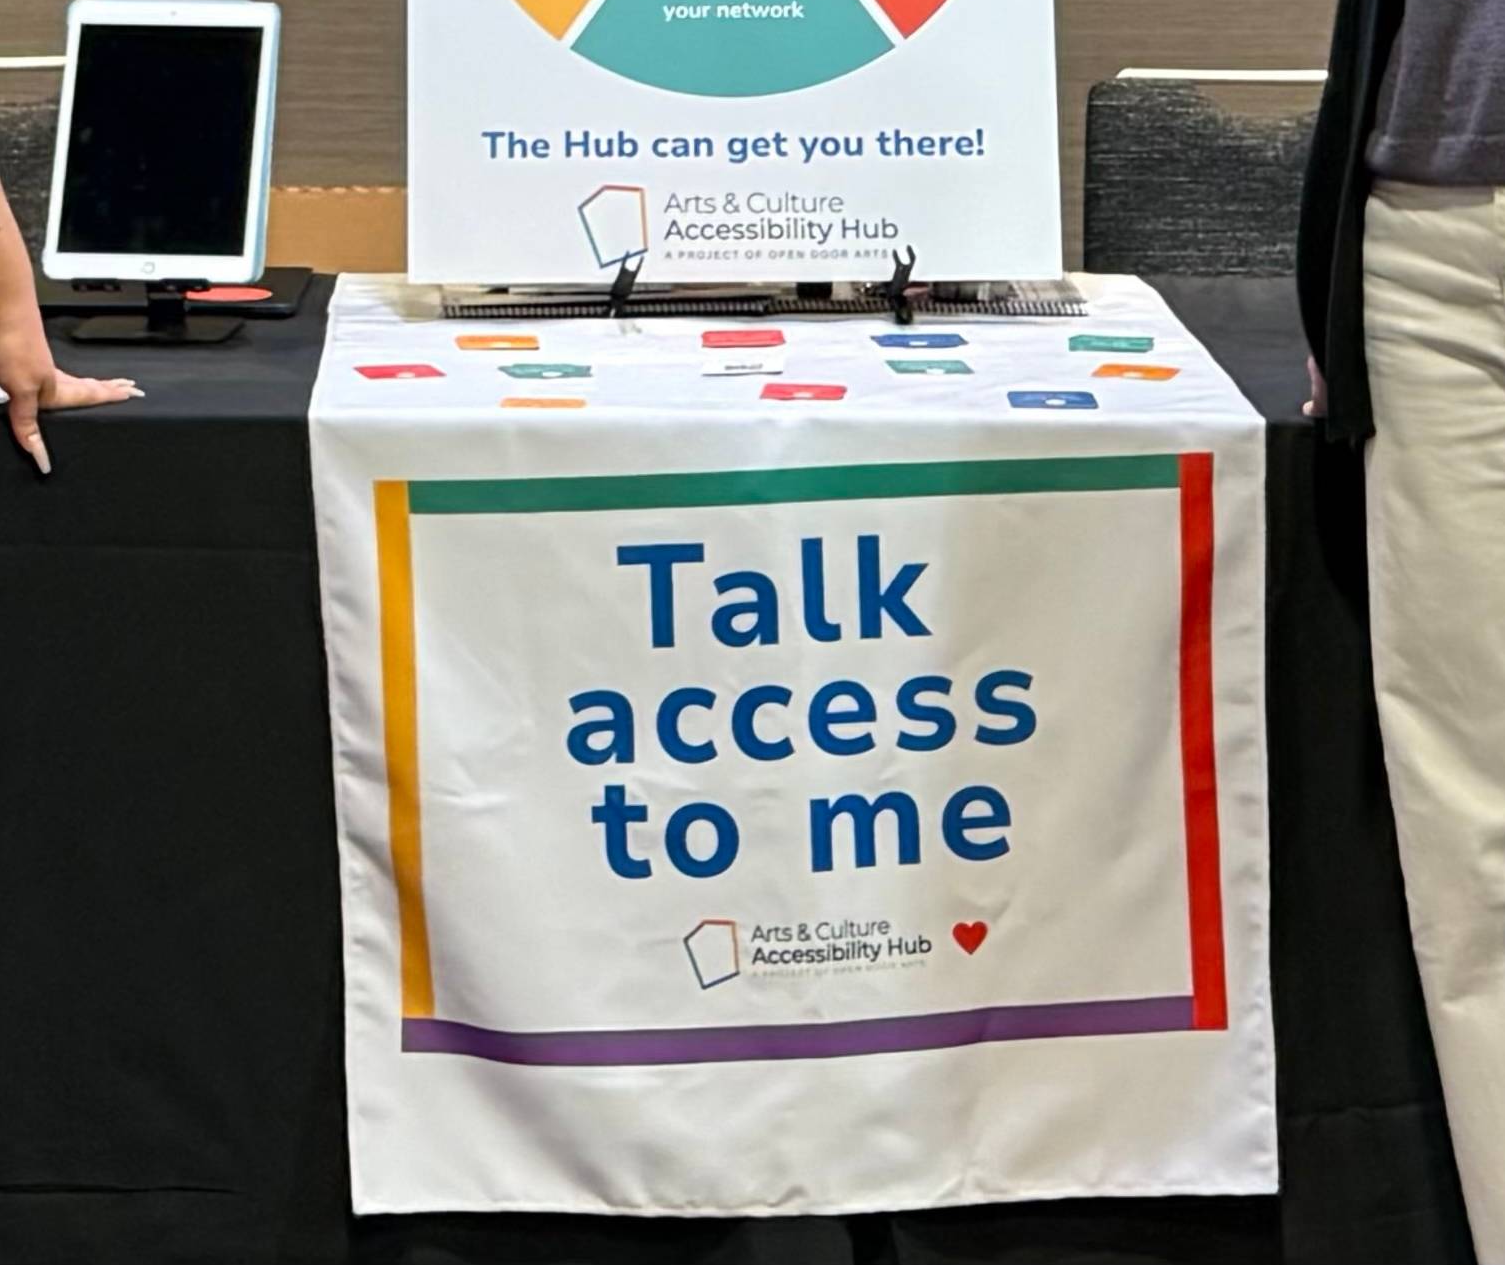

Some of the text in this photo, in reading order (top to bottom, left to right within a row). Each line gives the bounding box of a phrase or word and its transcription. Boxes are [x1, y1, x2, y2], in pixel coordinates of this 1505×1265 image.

[662, 0, 805, 22] your network
[482, 128, 985, 164] The Hub can get you there!
[663, 192, 845, 214] Arts & Culture
[663, 217, 899, 245] Accessibility Hub
[664, 249, 888, 260] A PROJECT OF OPEN DOOR ARTS
[615, 533, 932, 650] Talk
[565, 667, 1039, 767] access
[590, 779, 1013, 880] to me
[750, 919, 891, 943] Arts & Culture
[751, 934, 933, 966] Accessibility Hub
